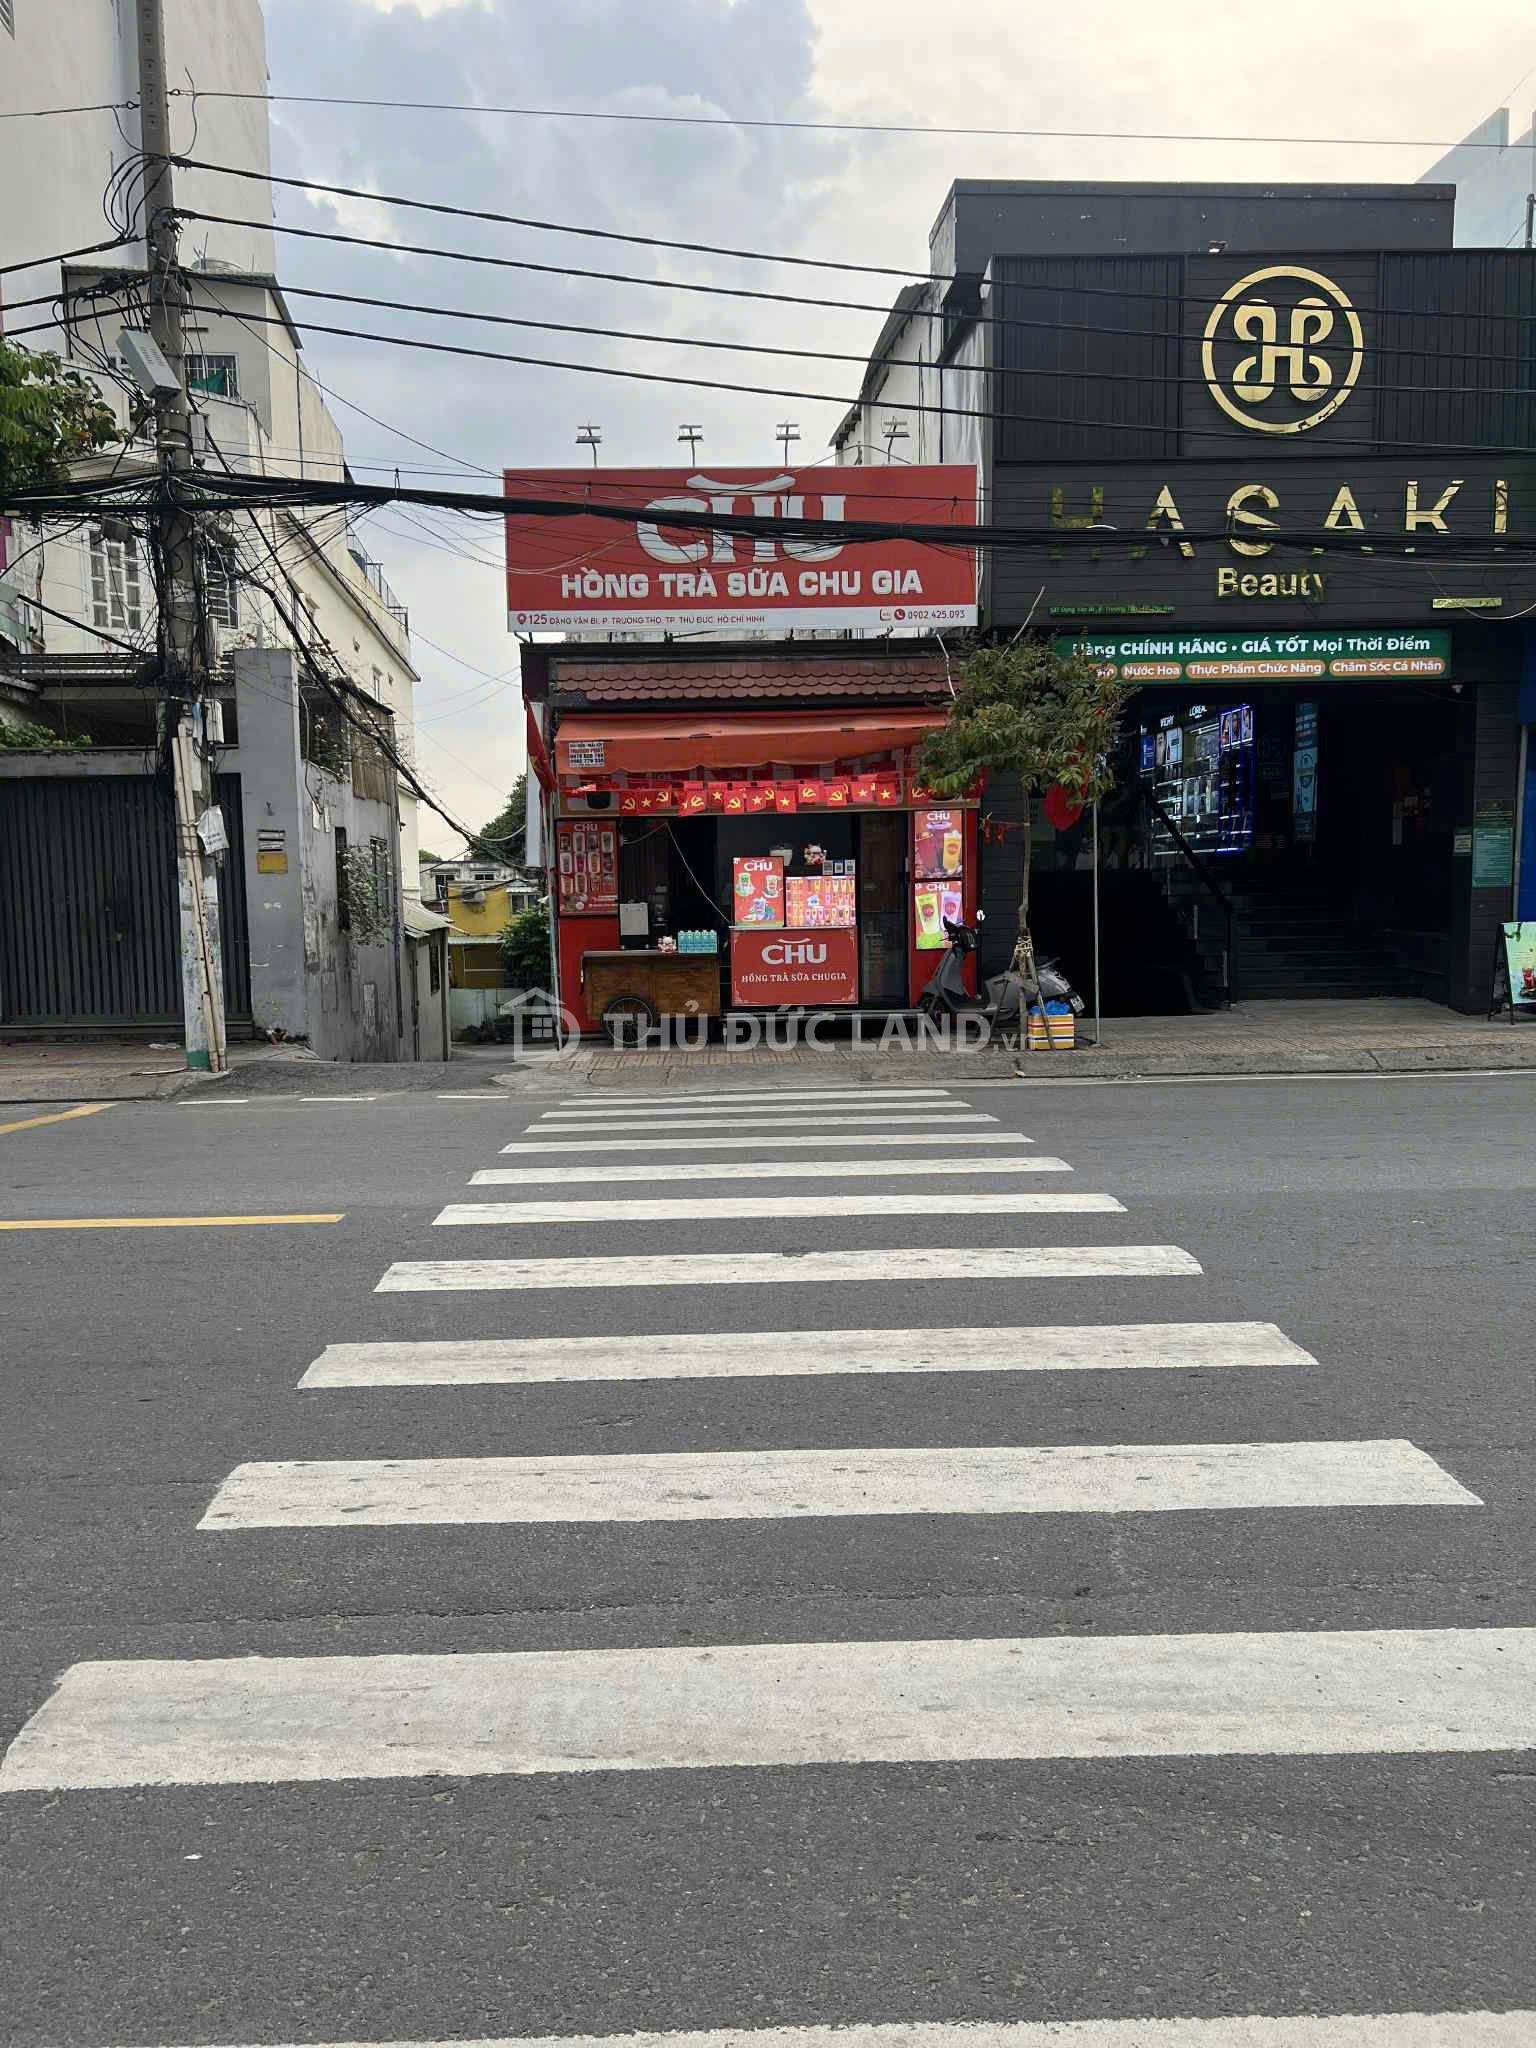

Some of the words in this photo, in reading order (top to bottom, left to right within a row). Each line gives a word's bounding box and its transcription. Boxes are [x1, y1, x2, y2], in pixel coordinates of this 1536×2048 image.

[1050, 479, 1510, 559] HASAKI
[561, 567, 649, 599] HỒNG
[659, 567, 718, 598] TRÀ
[727, 567, 790, 597] SỮA
[799, 570, 861, 596] CHU
[872, 569, 925, 595] GIA
[1217, 567, 1329, 603] Beauty
[529, 614, 548, 625] 125
[1120, 638, 1174, 656] CHÍNH
[1178, 637, 1228, 654] HÃNG
[1241, 636, 1272, 654] GIÁ
[1276, 635, 1309, 652] TỐT
[1313, 638, 1342, 655] Mọi
[1347, 637, 1382, 652] Thời
[1386, 635, 1431, 651] Điểm
[1157, 666, 1180, 676] Hoa
[1191, 664, 1219, 676] Thực
[1223, 663, 1256, 675] Phẩm
[1258, 662, 1288, 674] Chức
[1290, 662, 1322, 675] Năng
[1332, 661, 1367, 673] Chăm
[1369, 660, 1391, 672] Sóc
[1393, 659, 1409, 671] Cá
[1411, 659, 1442, 672] Nhân
[926, 812, 951, 821] CHU
[574, 823, 599, 832] CHU
[743, 862, 774, 873] CHU
[761, 943, 827, 966] CHU
